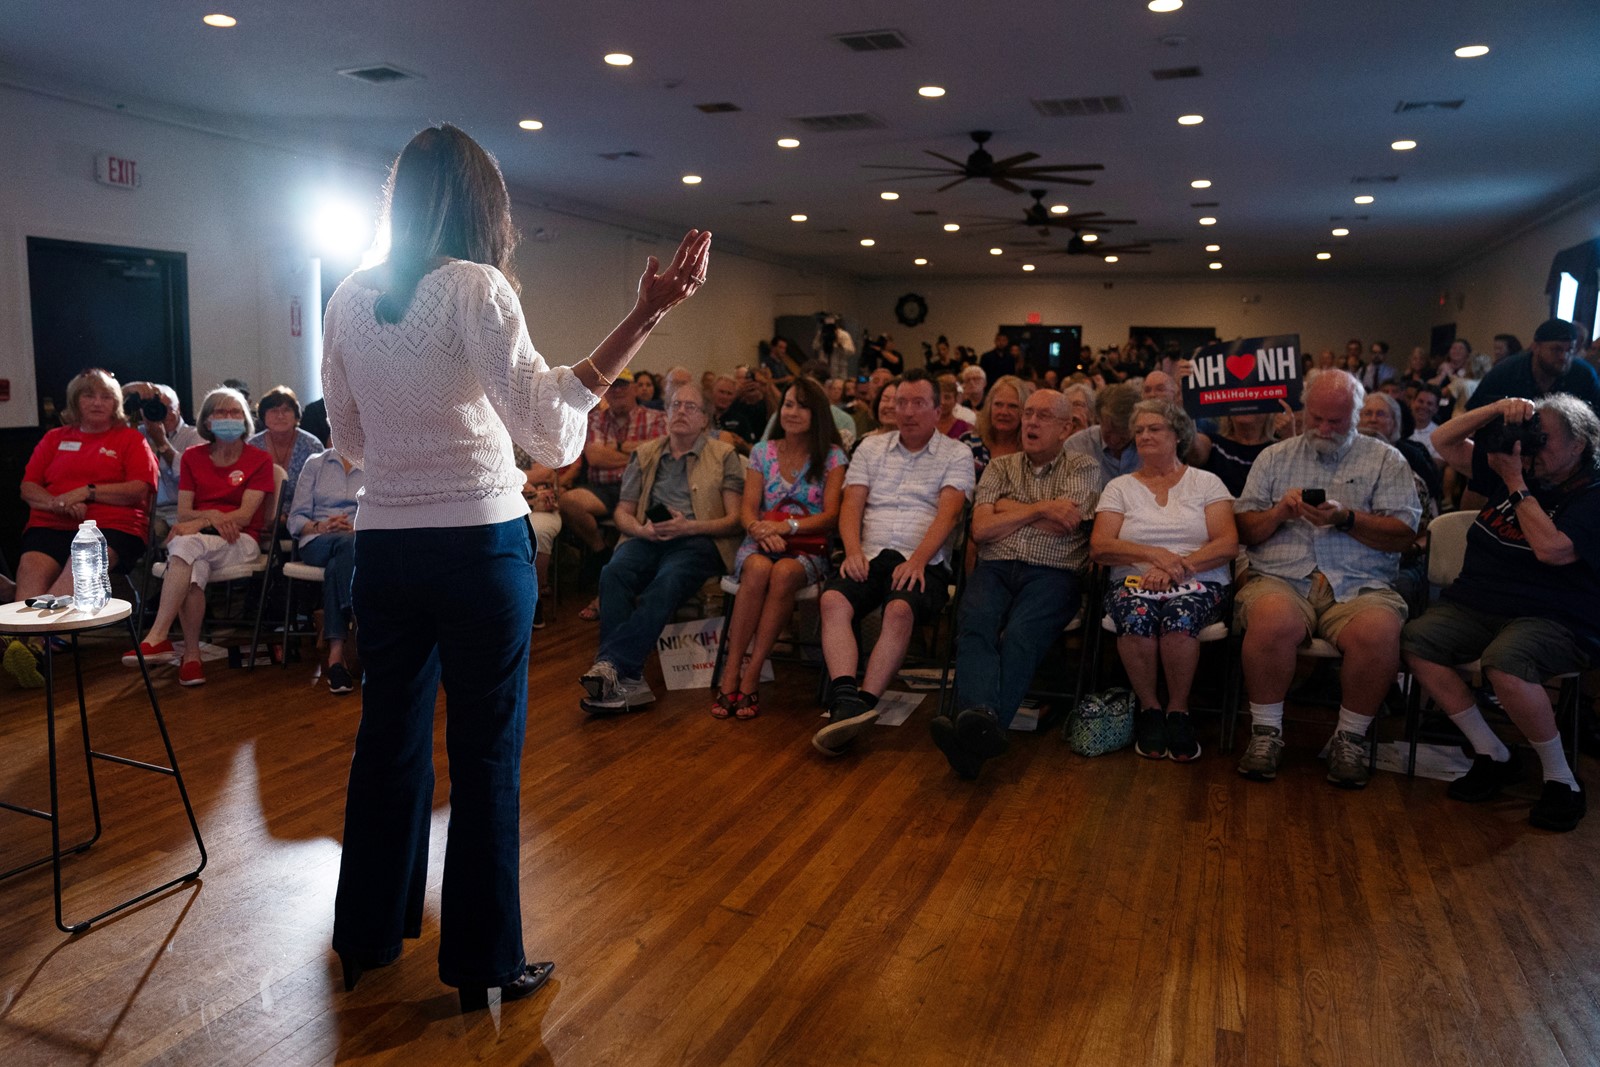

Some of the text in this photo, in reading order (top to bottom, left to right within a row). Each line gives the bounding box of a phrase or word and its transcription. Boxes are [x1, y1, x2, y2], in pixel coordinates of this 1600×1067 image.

[108, 157, 136, 185] EXIT
[1188, 346, 1296, 389] NH NH
[1204, 388, 1283, 401] NikkiHaley.com
[692, 662, 714, 670] NIKK
